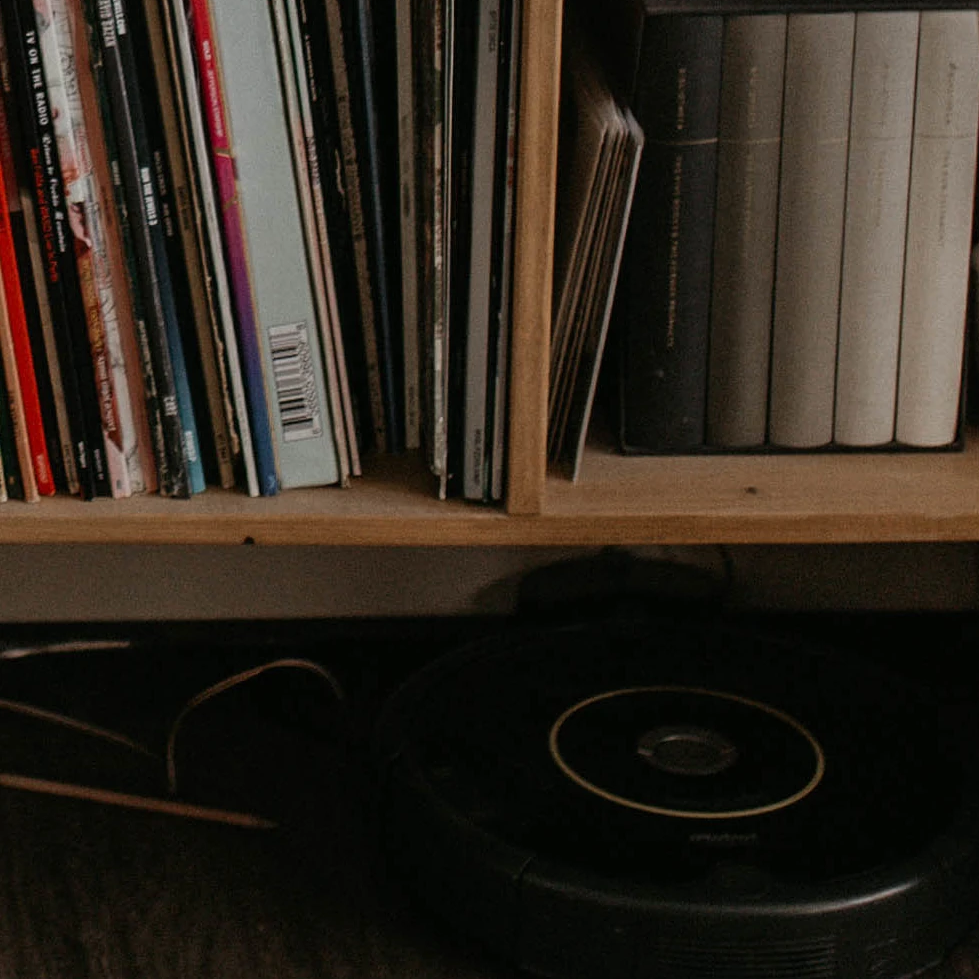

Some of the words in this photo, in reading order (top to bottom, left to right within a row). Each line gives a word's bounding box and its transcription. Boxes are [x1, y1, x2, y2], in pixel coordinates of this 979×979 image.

[25, 31, 35, 45] TV
[100, 20, 115, 48] BAZAN
[27, 49, 39, 65] ON
[31, 68, 43, 89] THE
[34, 91, 49, 126] RADIO
